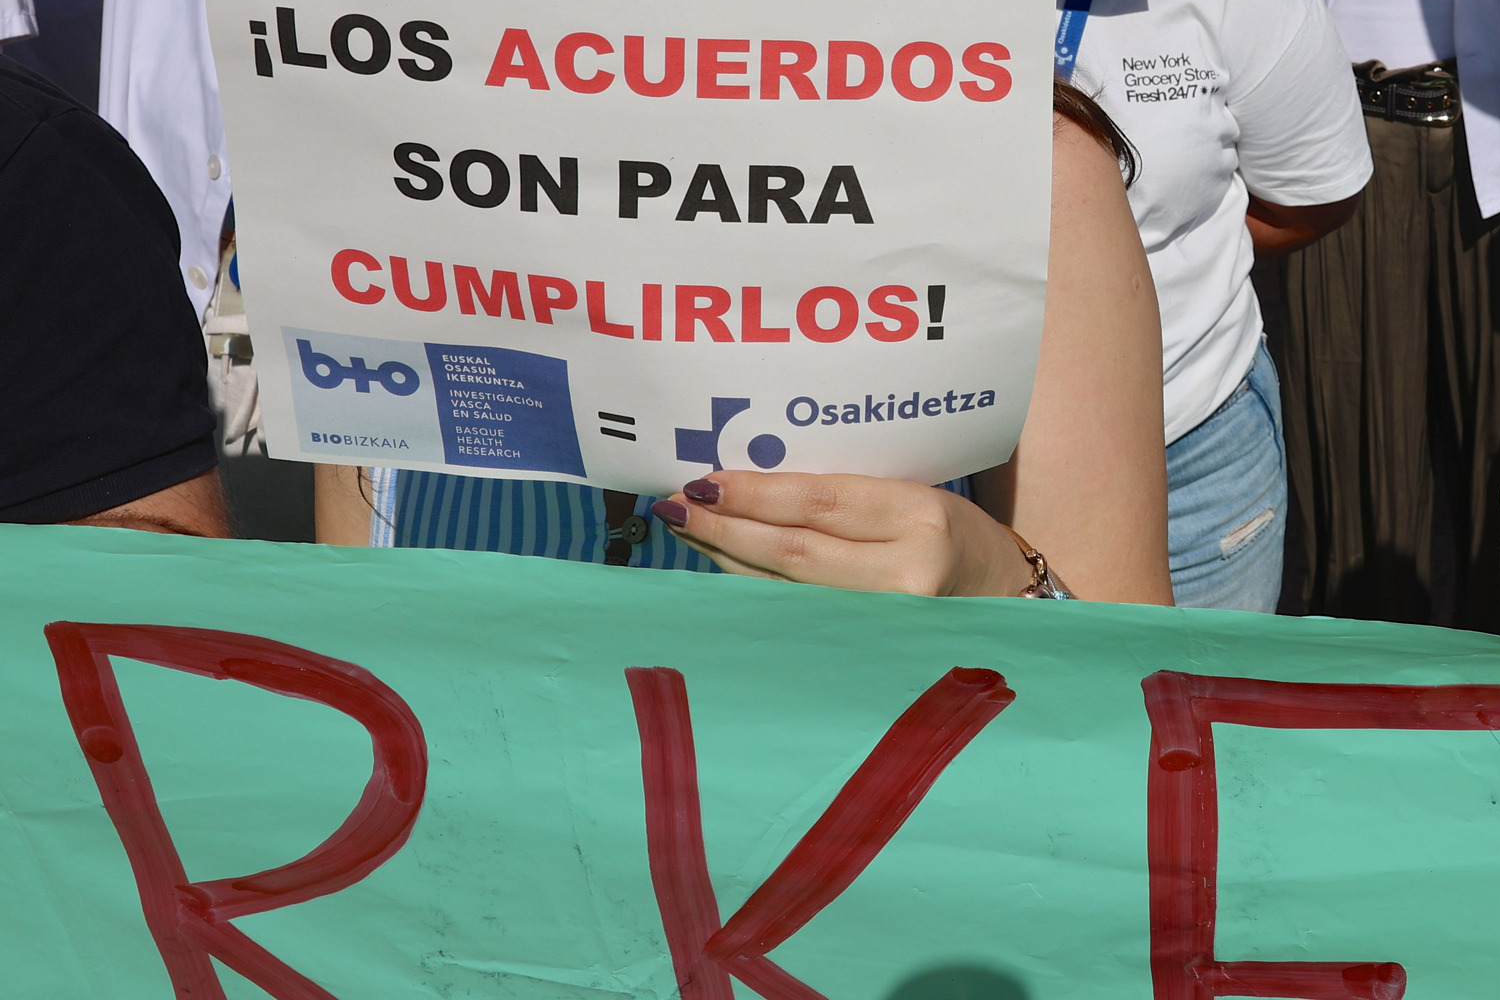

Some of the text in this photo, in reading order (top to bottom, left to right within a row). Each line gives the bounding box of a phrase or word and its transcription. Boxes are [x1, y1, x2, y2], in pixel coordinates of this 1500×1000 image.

[250, 6, 1012, 102] ¡LOS ACUERDOS
[1122, 53, 1191, 71] New York
[1124, 73, 1181, 87] Grocery
[1126, 85, 1198, 102] Fresh 24/7
[394, 142, 874, 224] SON PARA
[331, 248, 946, 343] CUMPLIRLOS!
[442, 354, 490, 365] EUSKAL
[444, 364, 496, 375] OSASUN
[447, 373, 525, 389] IKERKUNTZA
[450, 390, 543, 408] INVESTIGACIÓN
[450, 400, 492, 410] VASCA
[453, 410, 512, 422] EN SALUD
[786, 389, 996, 427] Osakidetza
[456, 426, 504, 438] BASQUE
[311, 432, 410, 449] BIOBIZKAIA
[457, 437, 503, 446] HEALTH
[459, 446, 520, 458] RESEARCH
